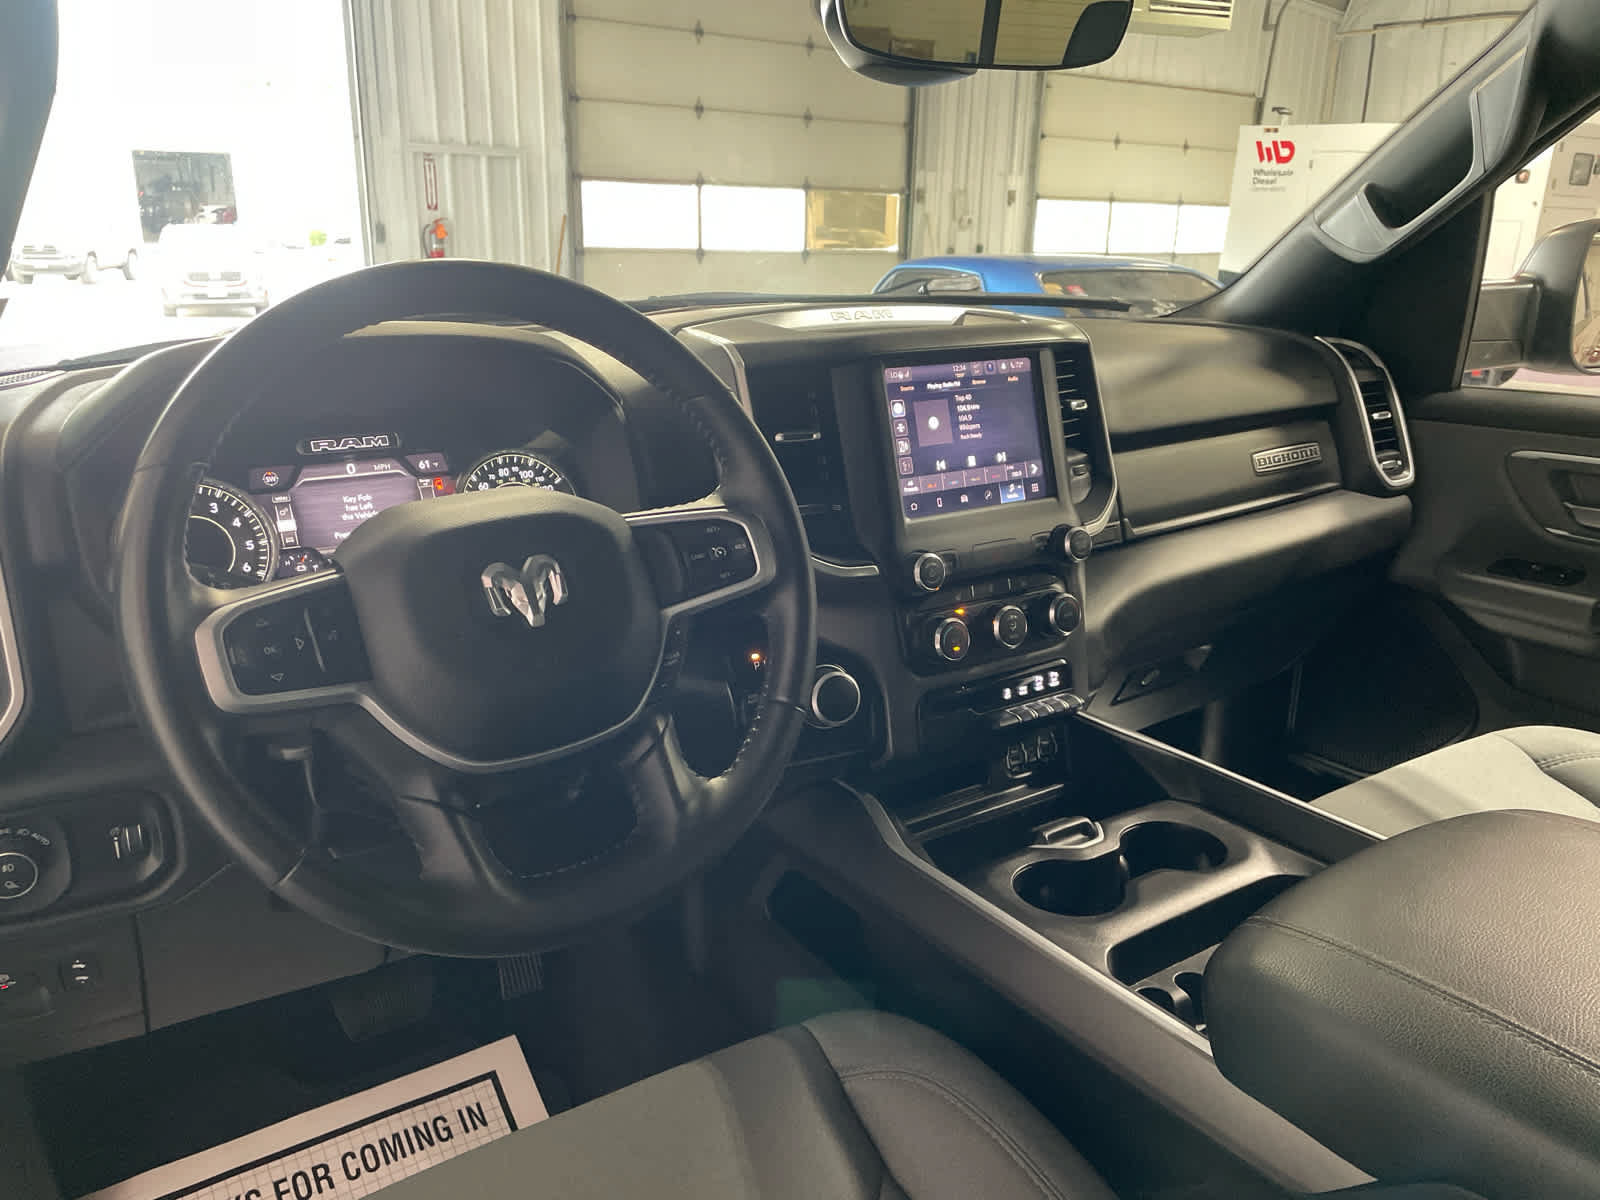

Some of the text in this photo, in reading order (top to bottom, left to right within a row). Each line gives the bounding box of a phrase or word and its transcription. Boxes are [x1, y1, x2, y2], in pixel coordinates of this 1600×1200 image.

[310, 435, 389, 451] RAM
[1256, 447, 1319, 467] BIGHORN
[345, 463, 391, 474] 0 MPH
[418, 460, 431, 469] 61
[498, 468, 509, 477] 80
[519, 470, 534, 479] 100
[209, 502, 218, 514] 3
[232, 517, 241, 528] 4
[245, 540, 255, 551] 5
[242, 562, 252, 573] 6
[273, 1102, 490, 1200] FOR COMING IN
